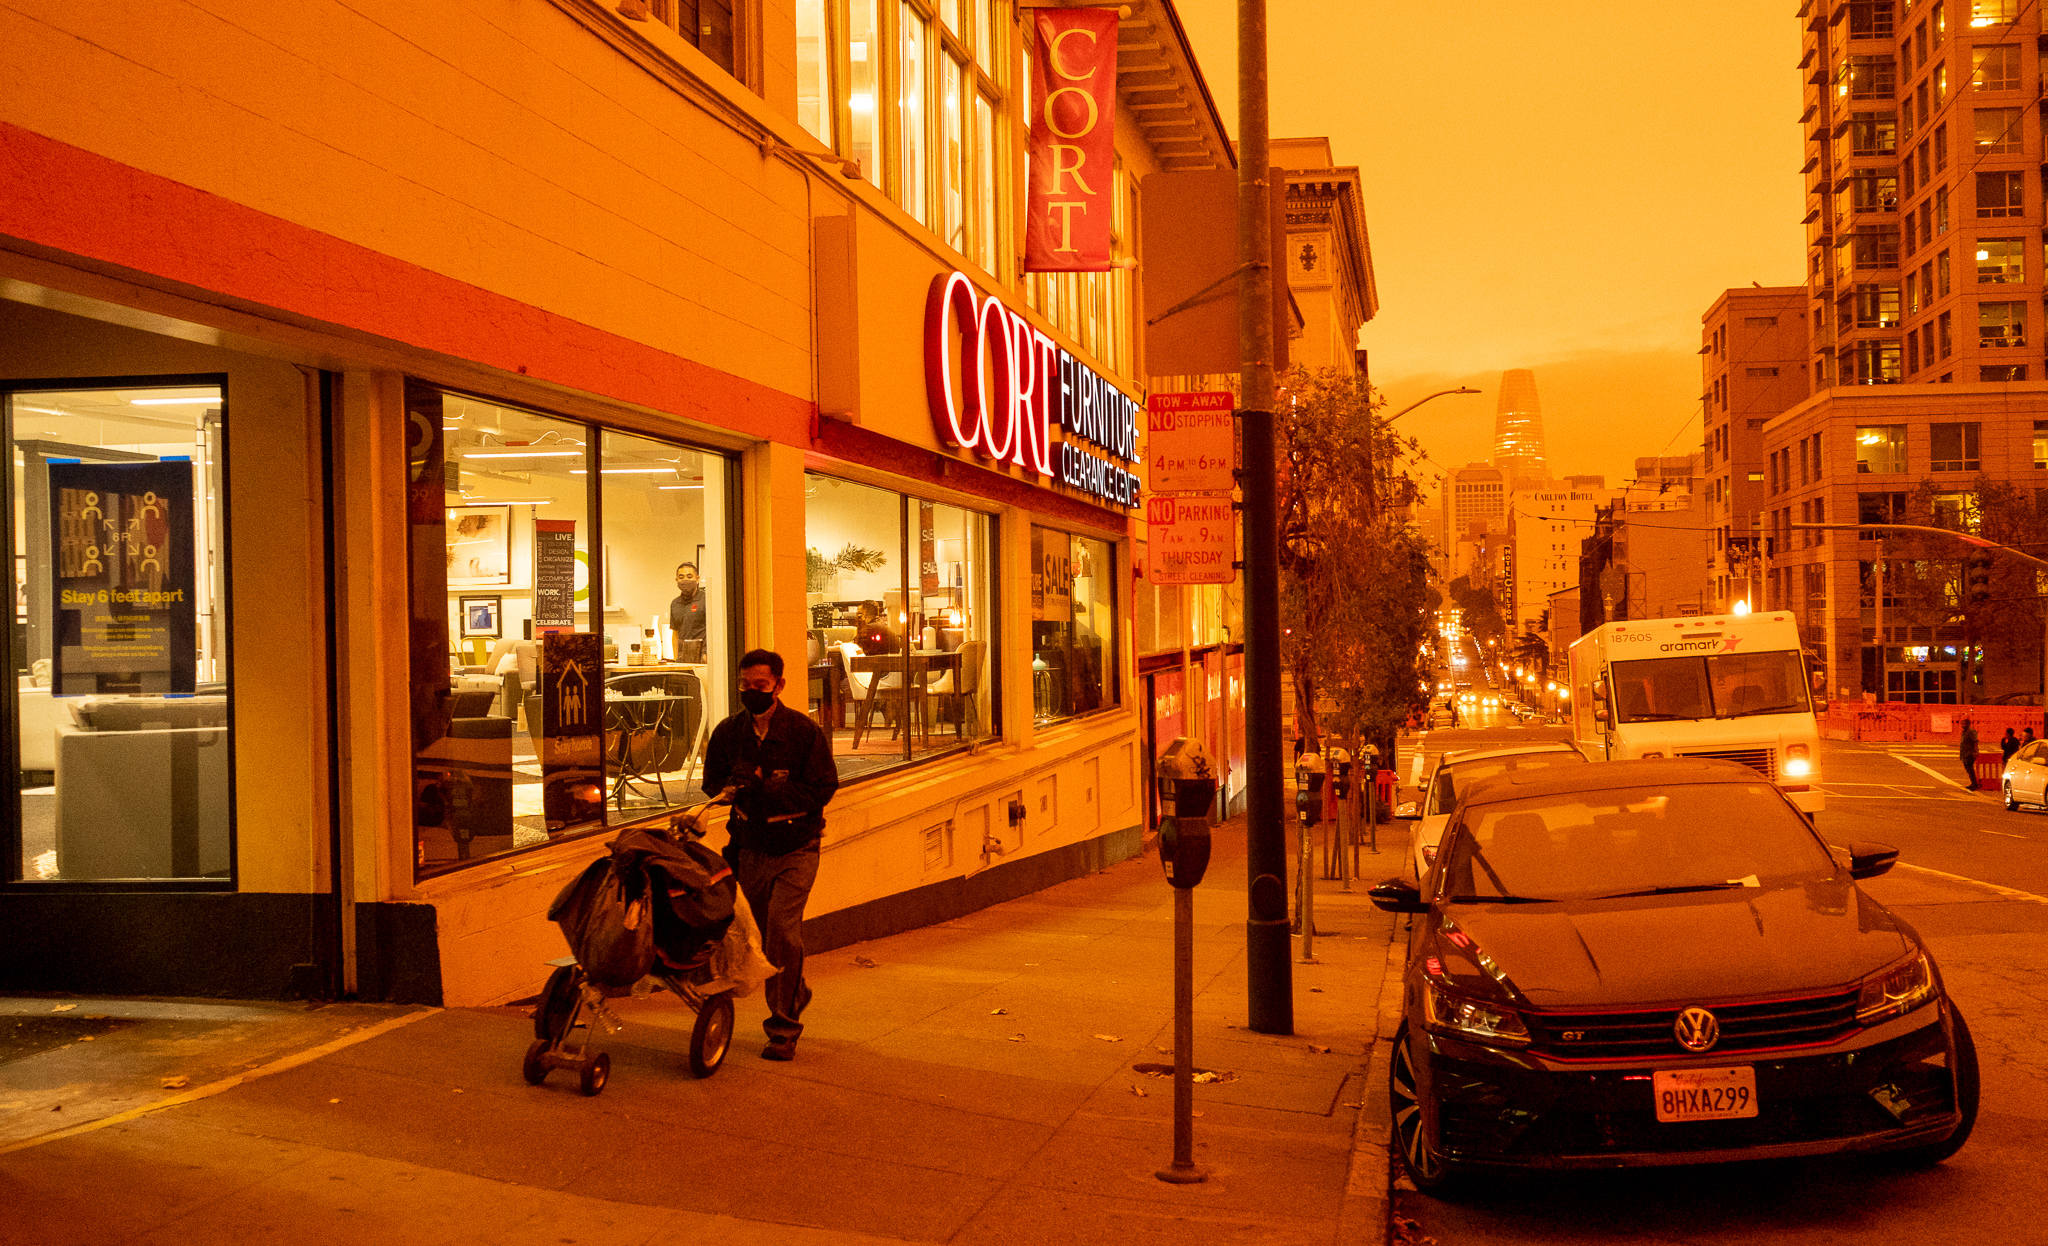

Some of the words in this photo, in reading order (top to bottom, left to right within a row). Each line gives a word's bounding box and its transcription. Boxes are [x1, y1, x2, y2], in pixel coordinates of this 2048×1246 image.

[1043, 28, 1099, 253] CORT
[939, 270, 1058, 478] CORT
[1059, 348, 1141, 465] FURNITURE
[1149, 410, 1175, 431] NO
[1176, 413, 1231, 428] STOPPING
[1061, 440, 1115, 499] CLEARANCE
[1155, 455, 1165, 471] 4
[1168, 459, 1188, 471] P.M.
[1198, 454, 1208, 470] 6
[1209, 458, 1229, 470] P.M.
[1534, 492, 1568, 502] CARLTON
[1570, 491, 1595, 501] HOTEL
[1149, 500, 1174, 523] NO
[1178, 505, 1230, 521] PARKING
[112, 532, 120, 542] 6
[121, 532, 132, 542] Ft
[554, 533, 575, 541] LIVE.
[1160, 527, 1169, 543] 7
[1199, 527, 1209, 543] 9
[1161, 550, 1223, 565] THURSDAY
[1504, 548, 1512, 578] HOTEL
[1045, 553, 1069, 597] SALE
[1158, 572, 1186, 581] STREET
[1189, 571, 1226, 580] CLEANING
[61, 589, 95, 606] Stay
[97, 589, 109, 603] 6
[110, 589, 140, 603] feet
[142, 588, 184, 605] apart
[537, 588, 561, 596] WORK.
[566, 582, 574, 619] BRIGHTEN
[1504, 578, 1513, 620] CARLTON
[541, 611, 560, 619] relax
[1610, 633, 1653, 644] 18760S
[1659, 639, 1720, 652] aramark
[1562, 1030, 1585, 1041] GT
[1675, 1073, 1737, 1087] California
[1662, 1086, 1750, 1115] 8HXA299
